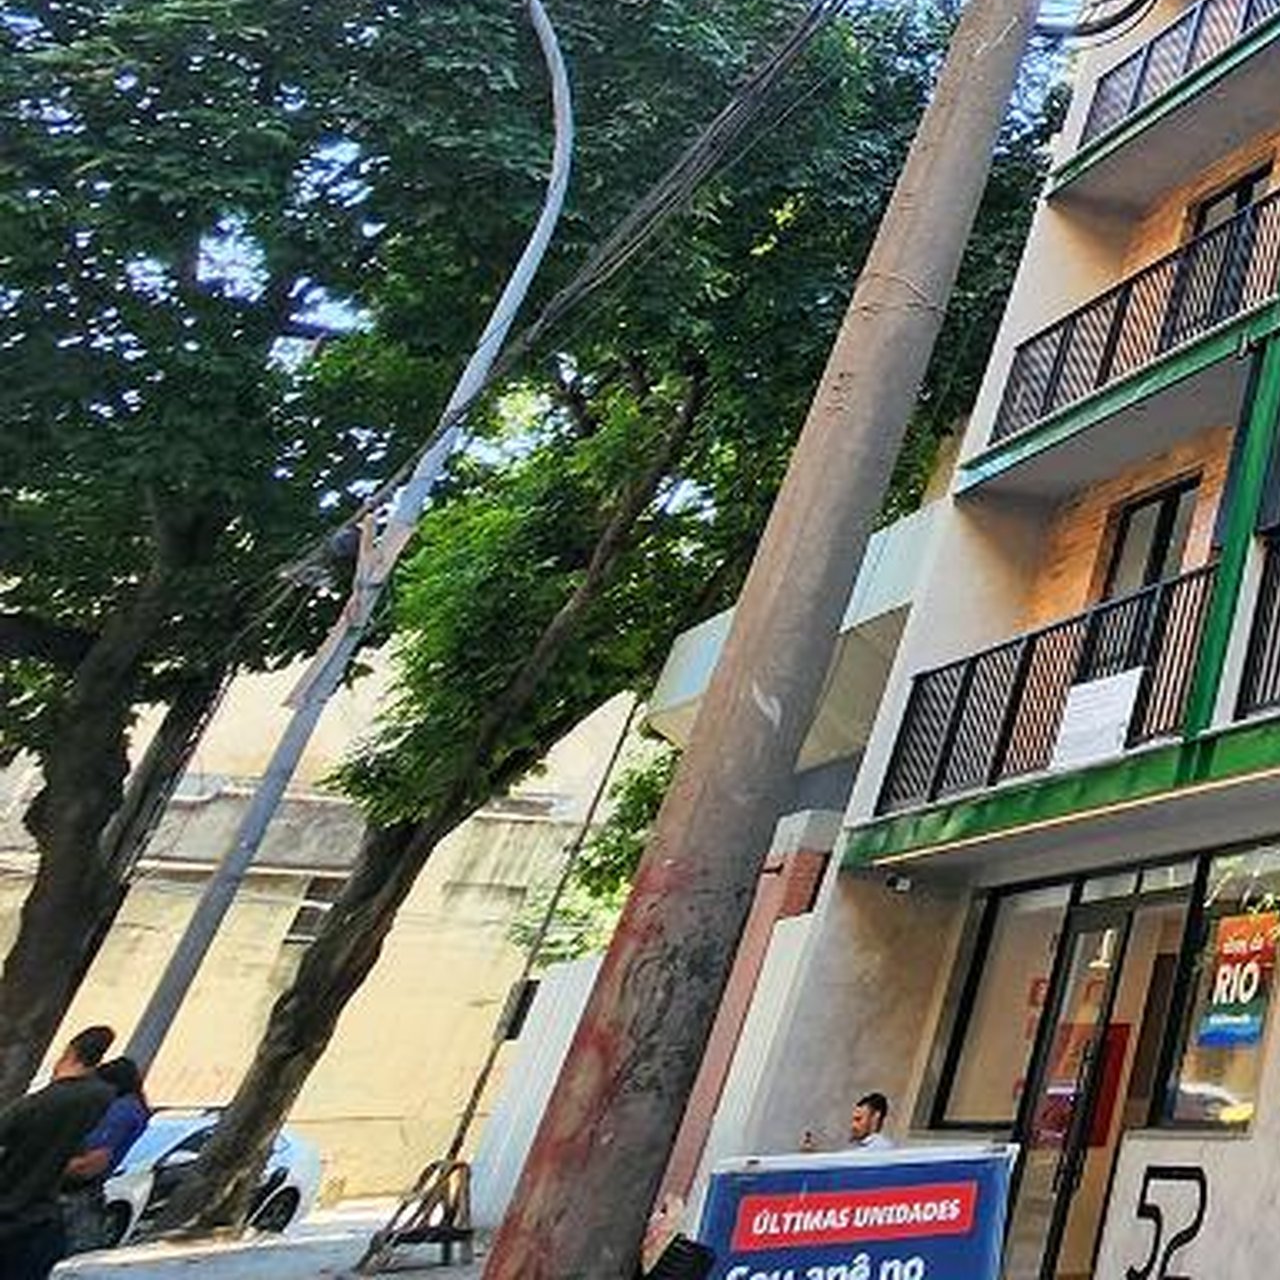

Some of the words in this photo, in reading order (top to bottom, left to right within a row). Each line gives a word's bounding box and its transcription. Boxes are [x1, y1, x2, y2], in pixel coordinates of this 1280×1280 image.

[752, 1207, 850, 1235] ÚLTIMAS
[853, 1198, 961, 1228] UNIDADES
[879, 1255, 925, 1280] no
